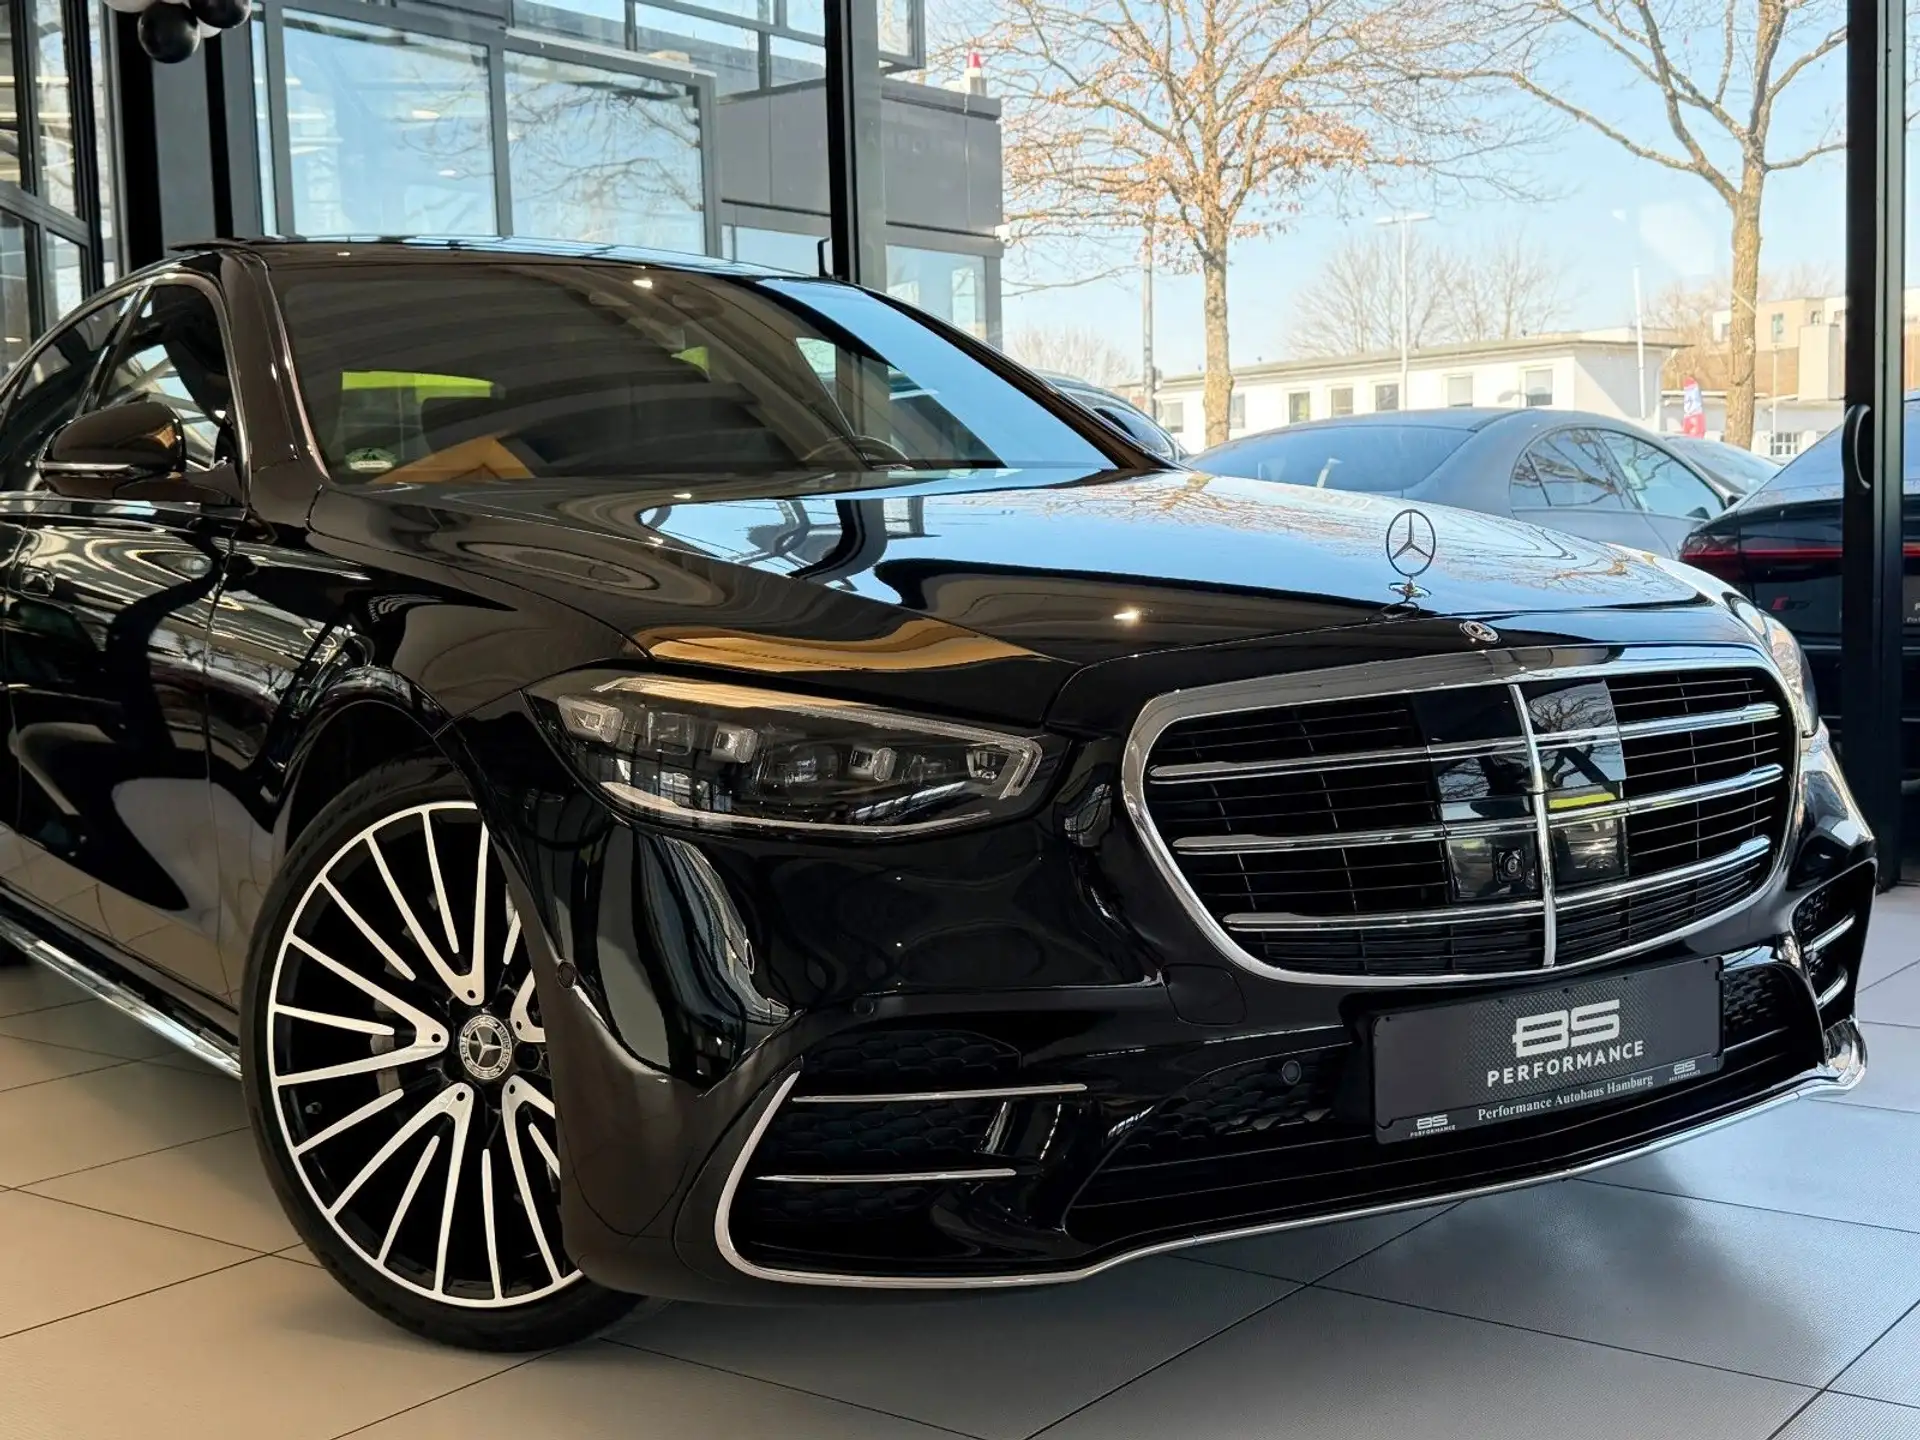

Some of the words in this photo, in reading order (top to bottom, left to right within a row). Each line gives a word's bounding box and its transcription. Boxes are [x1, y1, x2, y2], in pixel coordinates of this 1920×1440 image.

[1487, 1040, 1644, 1087] PERFORMANCE
[1478, 1098, 1551, 1121] Performance
[1554, 1087, 1604, 1106] Autohaus
[1607, 1075, 1653, 1094] Hamburg
